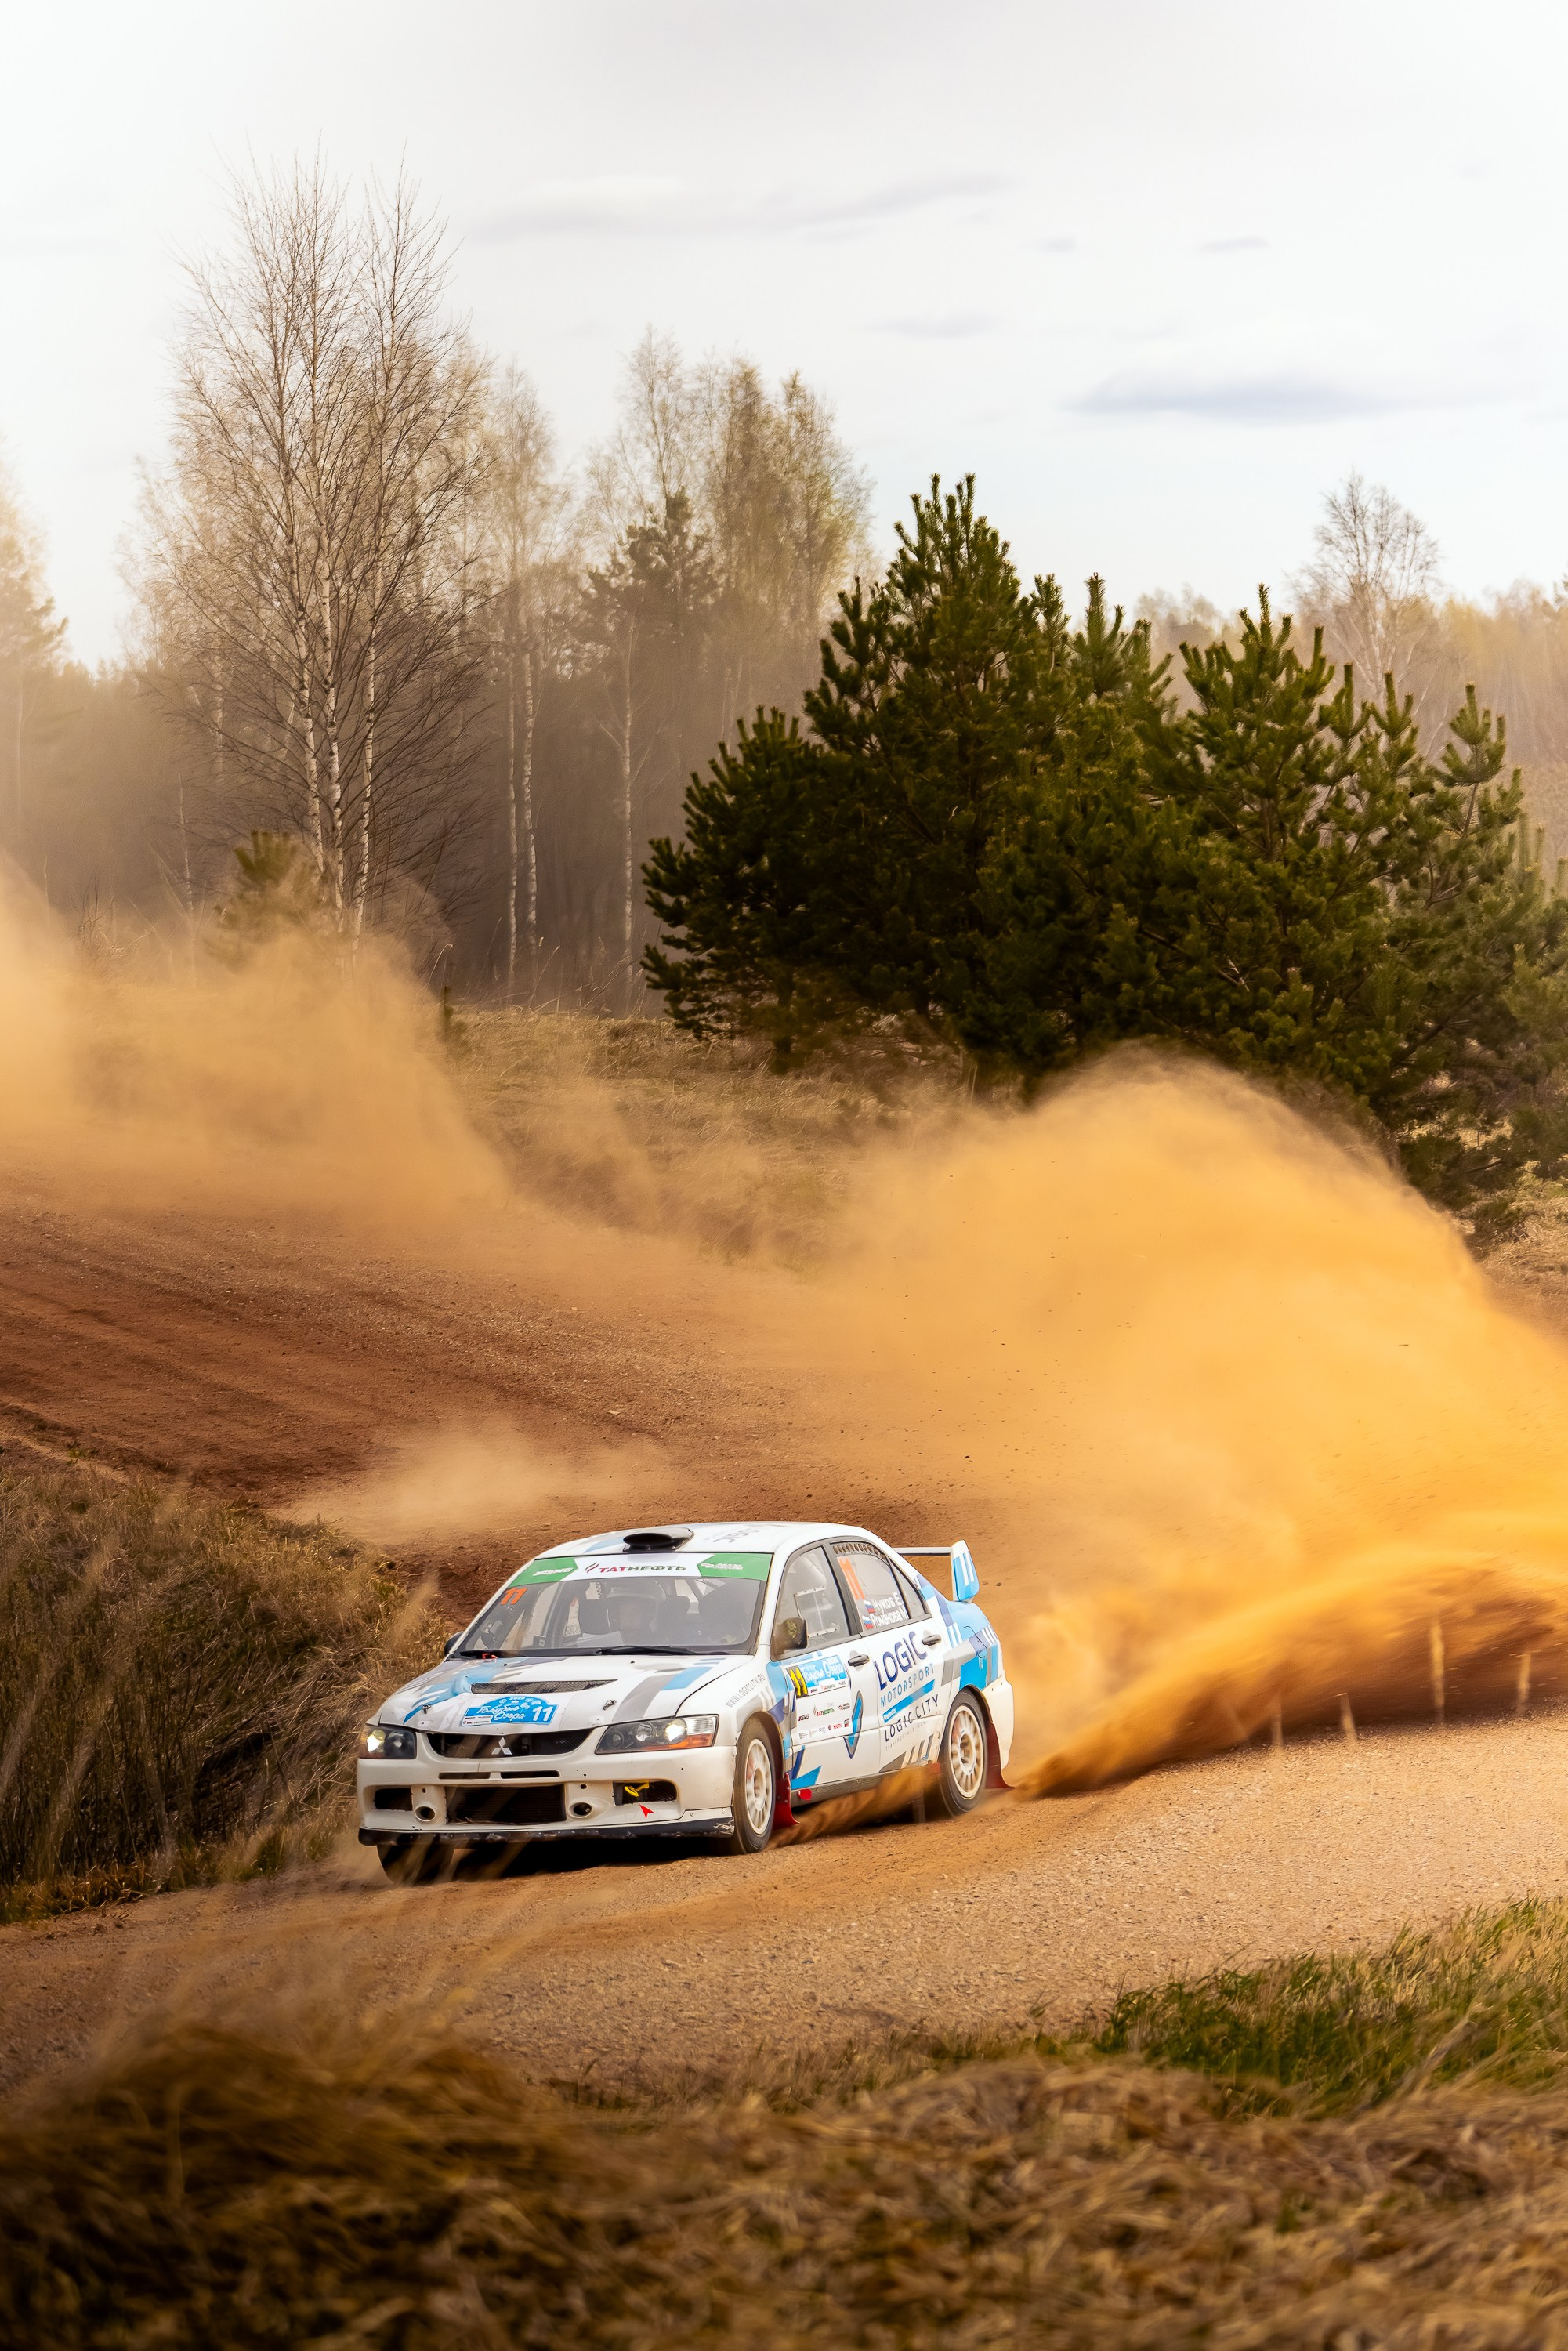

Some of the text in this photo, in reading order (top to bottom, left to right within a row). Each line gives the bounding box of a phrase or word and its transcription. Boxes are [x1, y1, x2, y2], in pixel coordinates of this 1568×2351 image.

[501, 1587, 527, 1605] 11
[871, 1597, 896, 1614] Чуков
[874, 1631, 928, 1690] LOGIC
[725, 1672, 766, 1708] WWW.LOGICCITY.RU
[790, 1668, 809, 1697] 11
[880, 1663, 935, 1708] MOTORSPORT
[493, 1712, 526, 1722] Озера
[533, 1706, 553, 1722] 11
